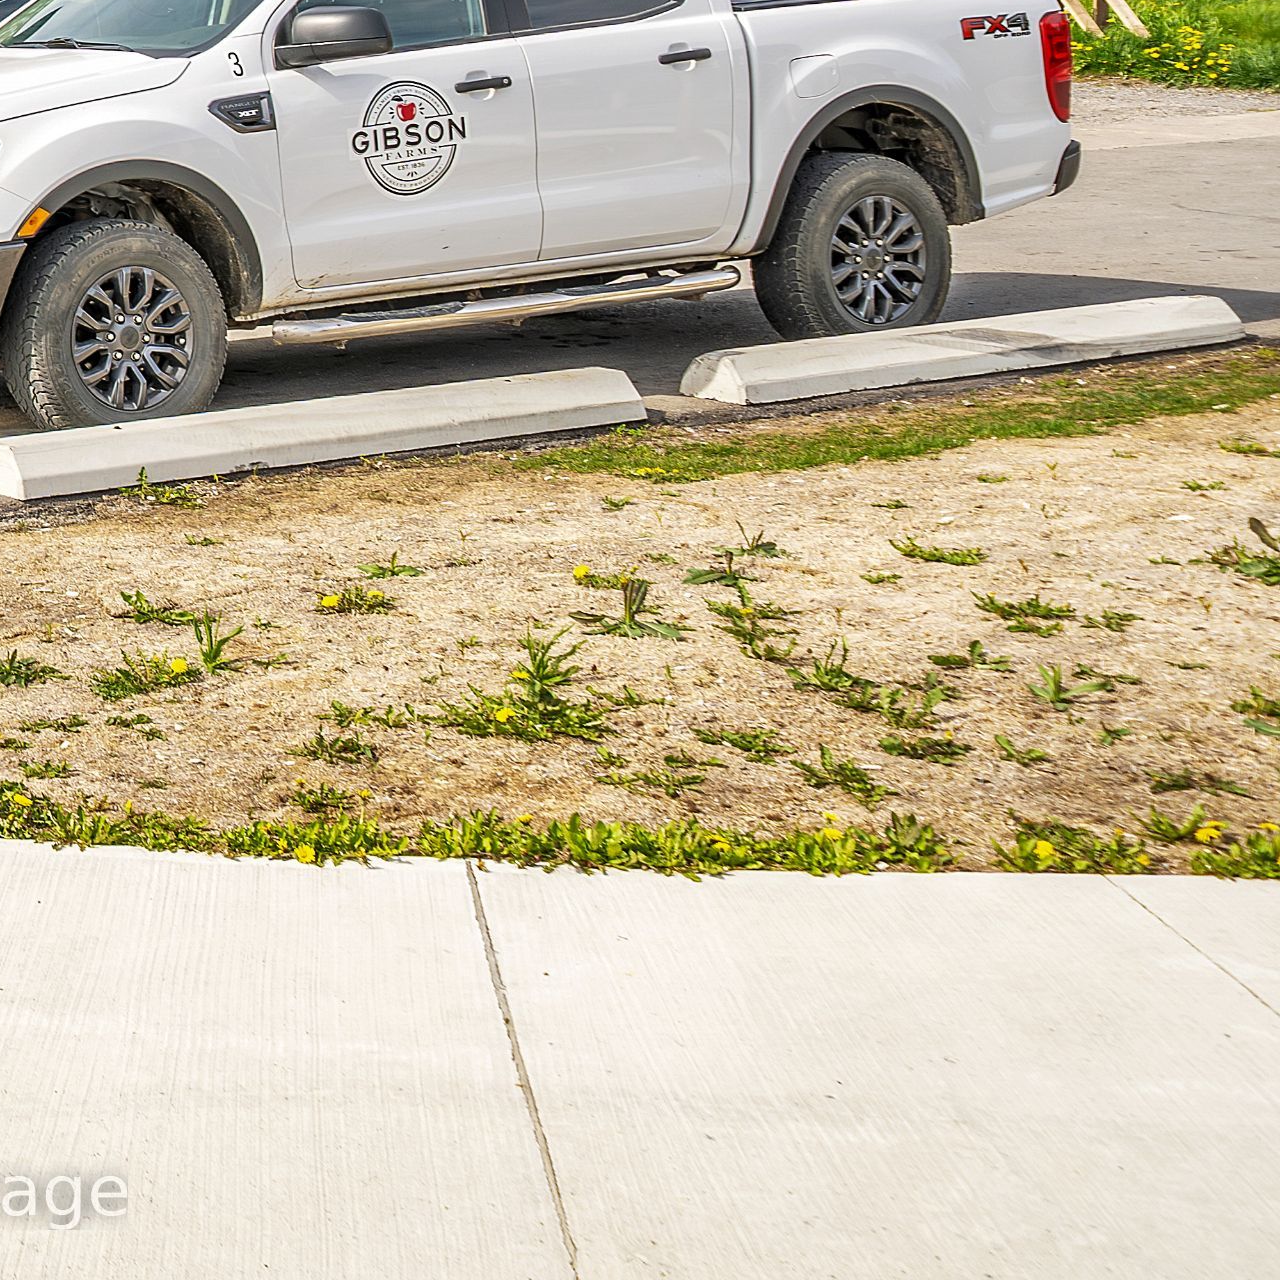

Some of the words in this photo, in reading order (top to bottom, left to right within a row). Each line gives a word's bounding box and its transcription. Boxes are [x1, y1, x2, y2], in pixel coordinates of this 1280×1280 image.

[960, 12, 1030, 40] FX4
[228, 51, 244, 76] 3
[237, 109, 259, 118] XLT
[352, 116, 466, 155] GIBSON
[385, 147, 439, 161] FARMS
